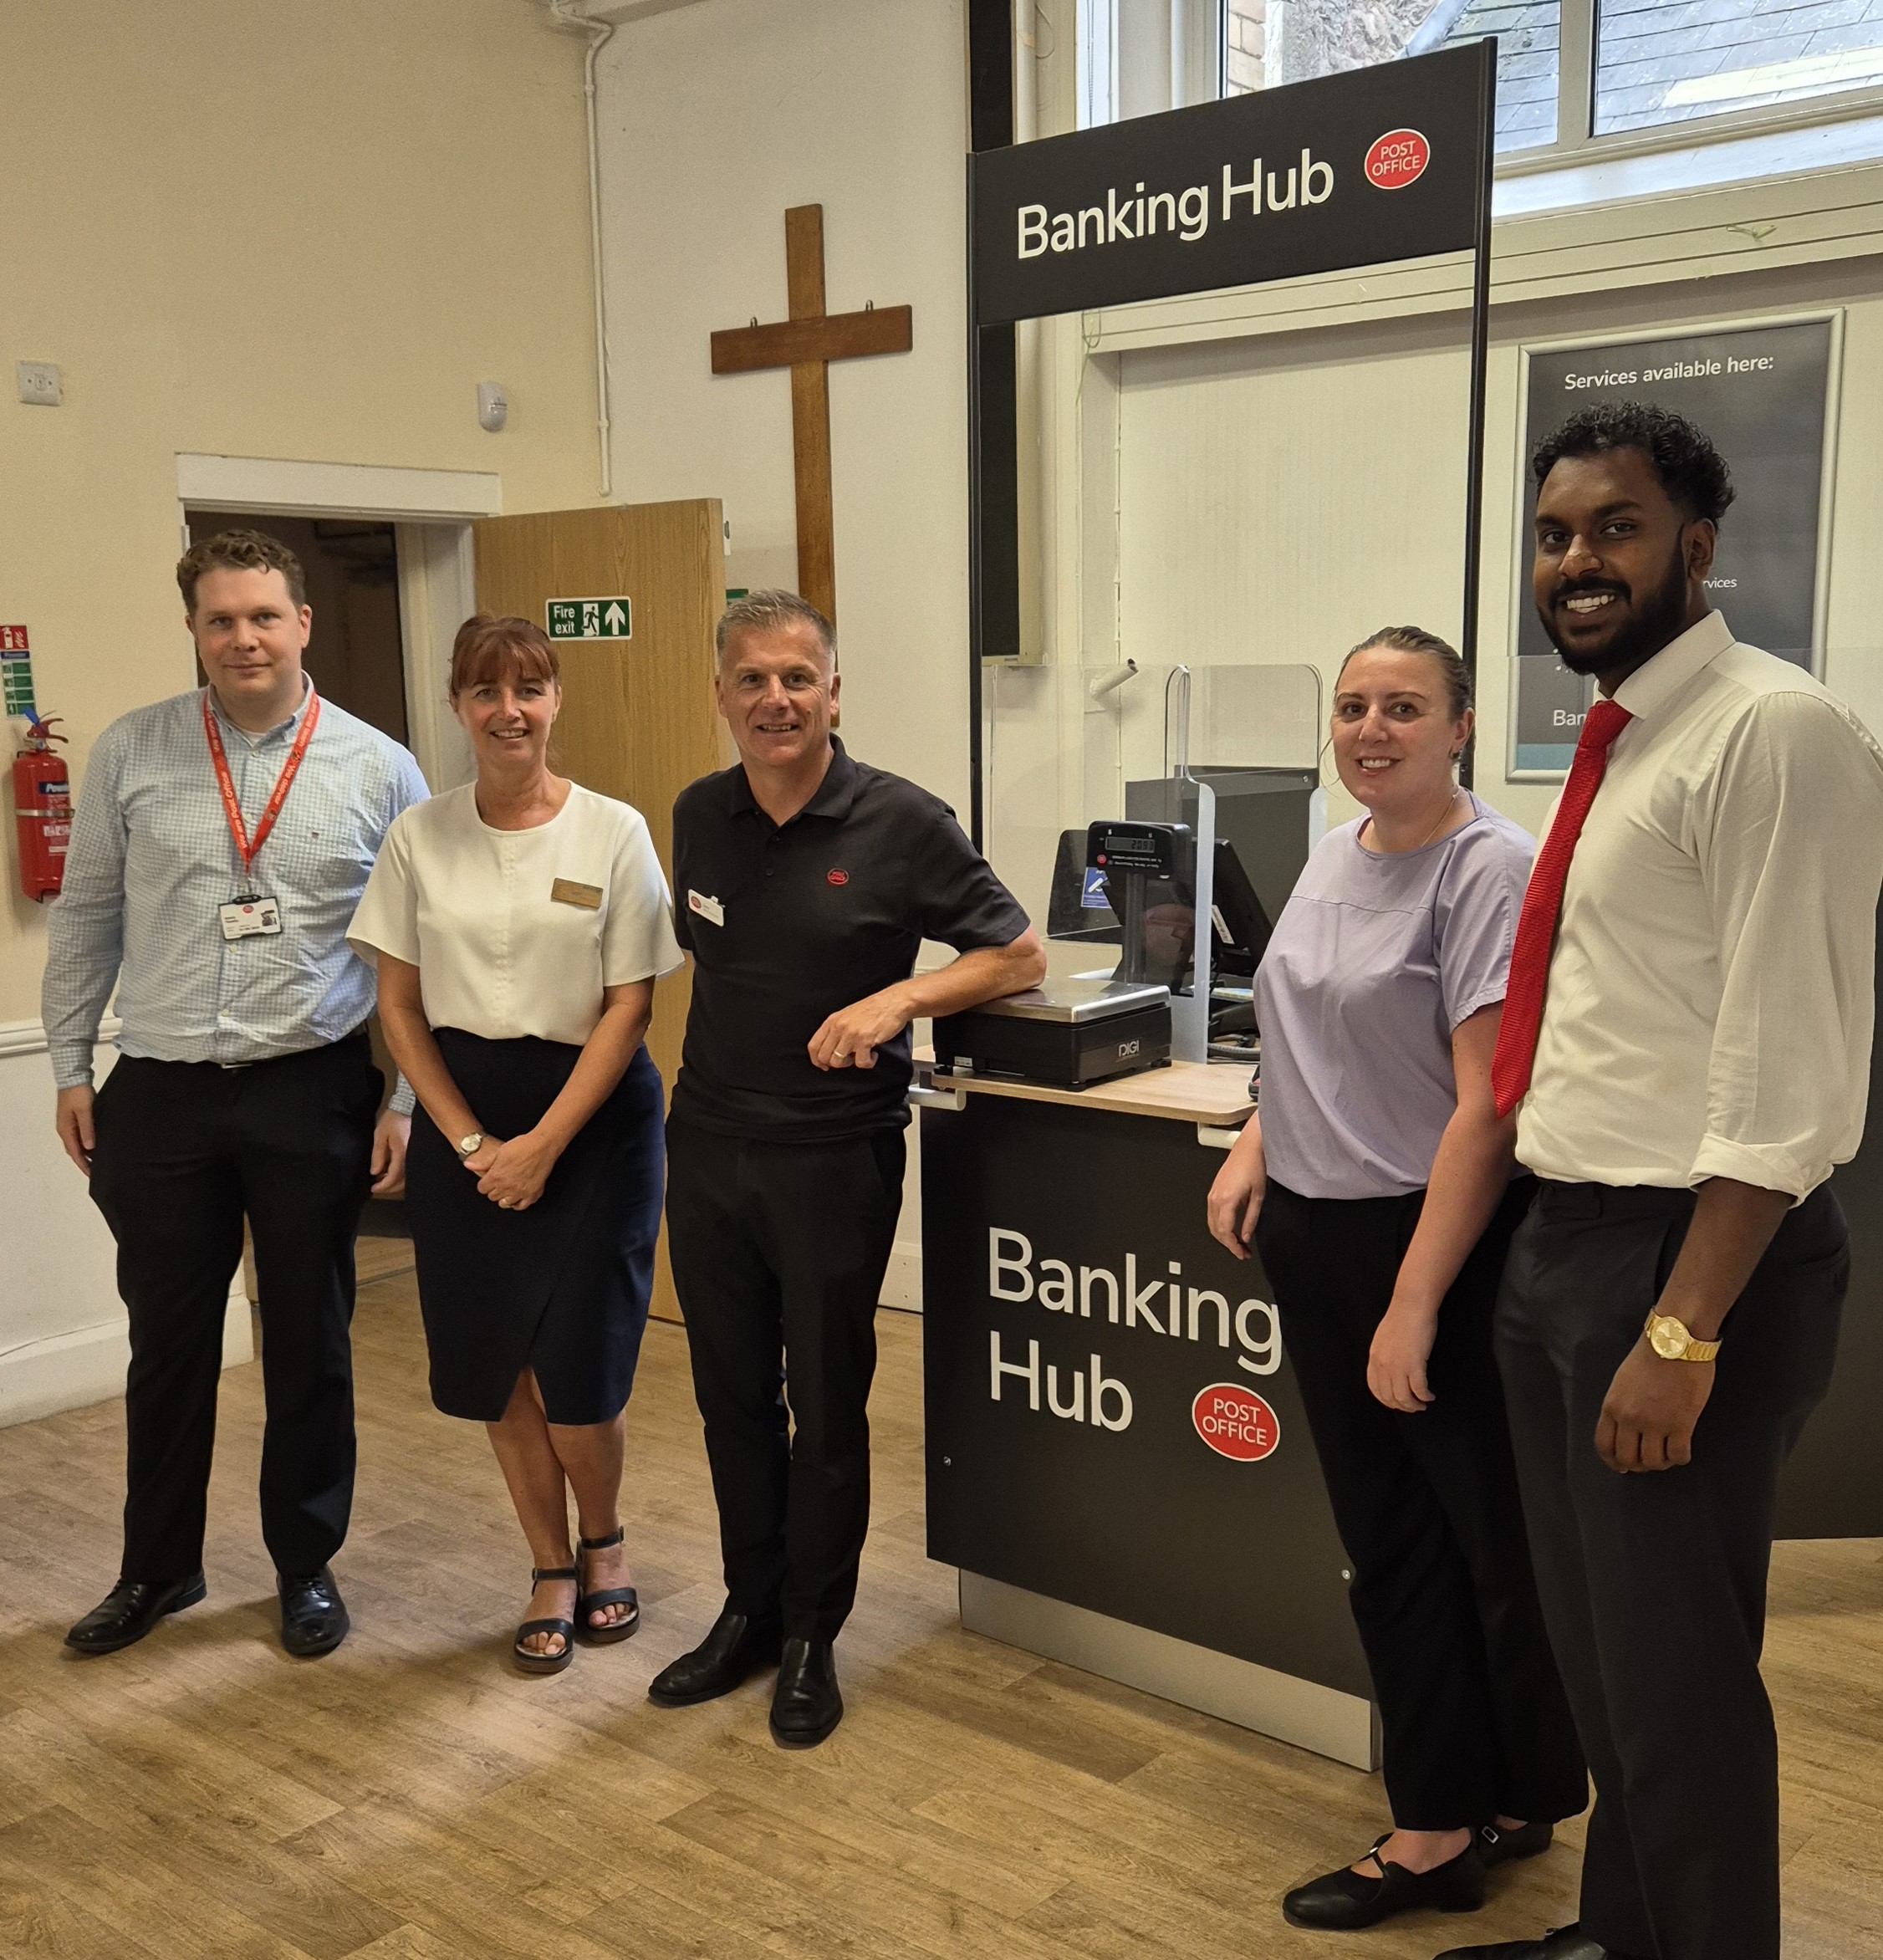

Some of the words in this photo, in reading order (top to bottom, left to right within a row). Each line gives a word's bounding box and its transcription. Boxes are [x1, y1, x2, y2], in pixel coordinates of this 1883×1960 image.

[1380, 140, 1416, 159] POST
[1371, 153, 1421, 177] OFFICE
[1018, 181, 1209, 259] Banking
[1222, 148, 1334, 221] Hub
[1564, 370, 1638, 390] Services
[1642, 358, 1722, 382] available
[1727, 355, 1774, 375] here:
[1702, 578, 1738, 589] rvices
[554, 605, 575, 619] Fire
[555, 620, 575, 635] exit
[1553, 709, 1587, 726] Ban
[1118, 1039, 1140, 1057] DIGI
[989, 1226, 1283, 1376] Banking
[990, 1330, 1134, 1432] Hub
[1213, 1397, 1261, 1423] POST
[1202, 1415, 1268, 1447] OFFICE
